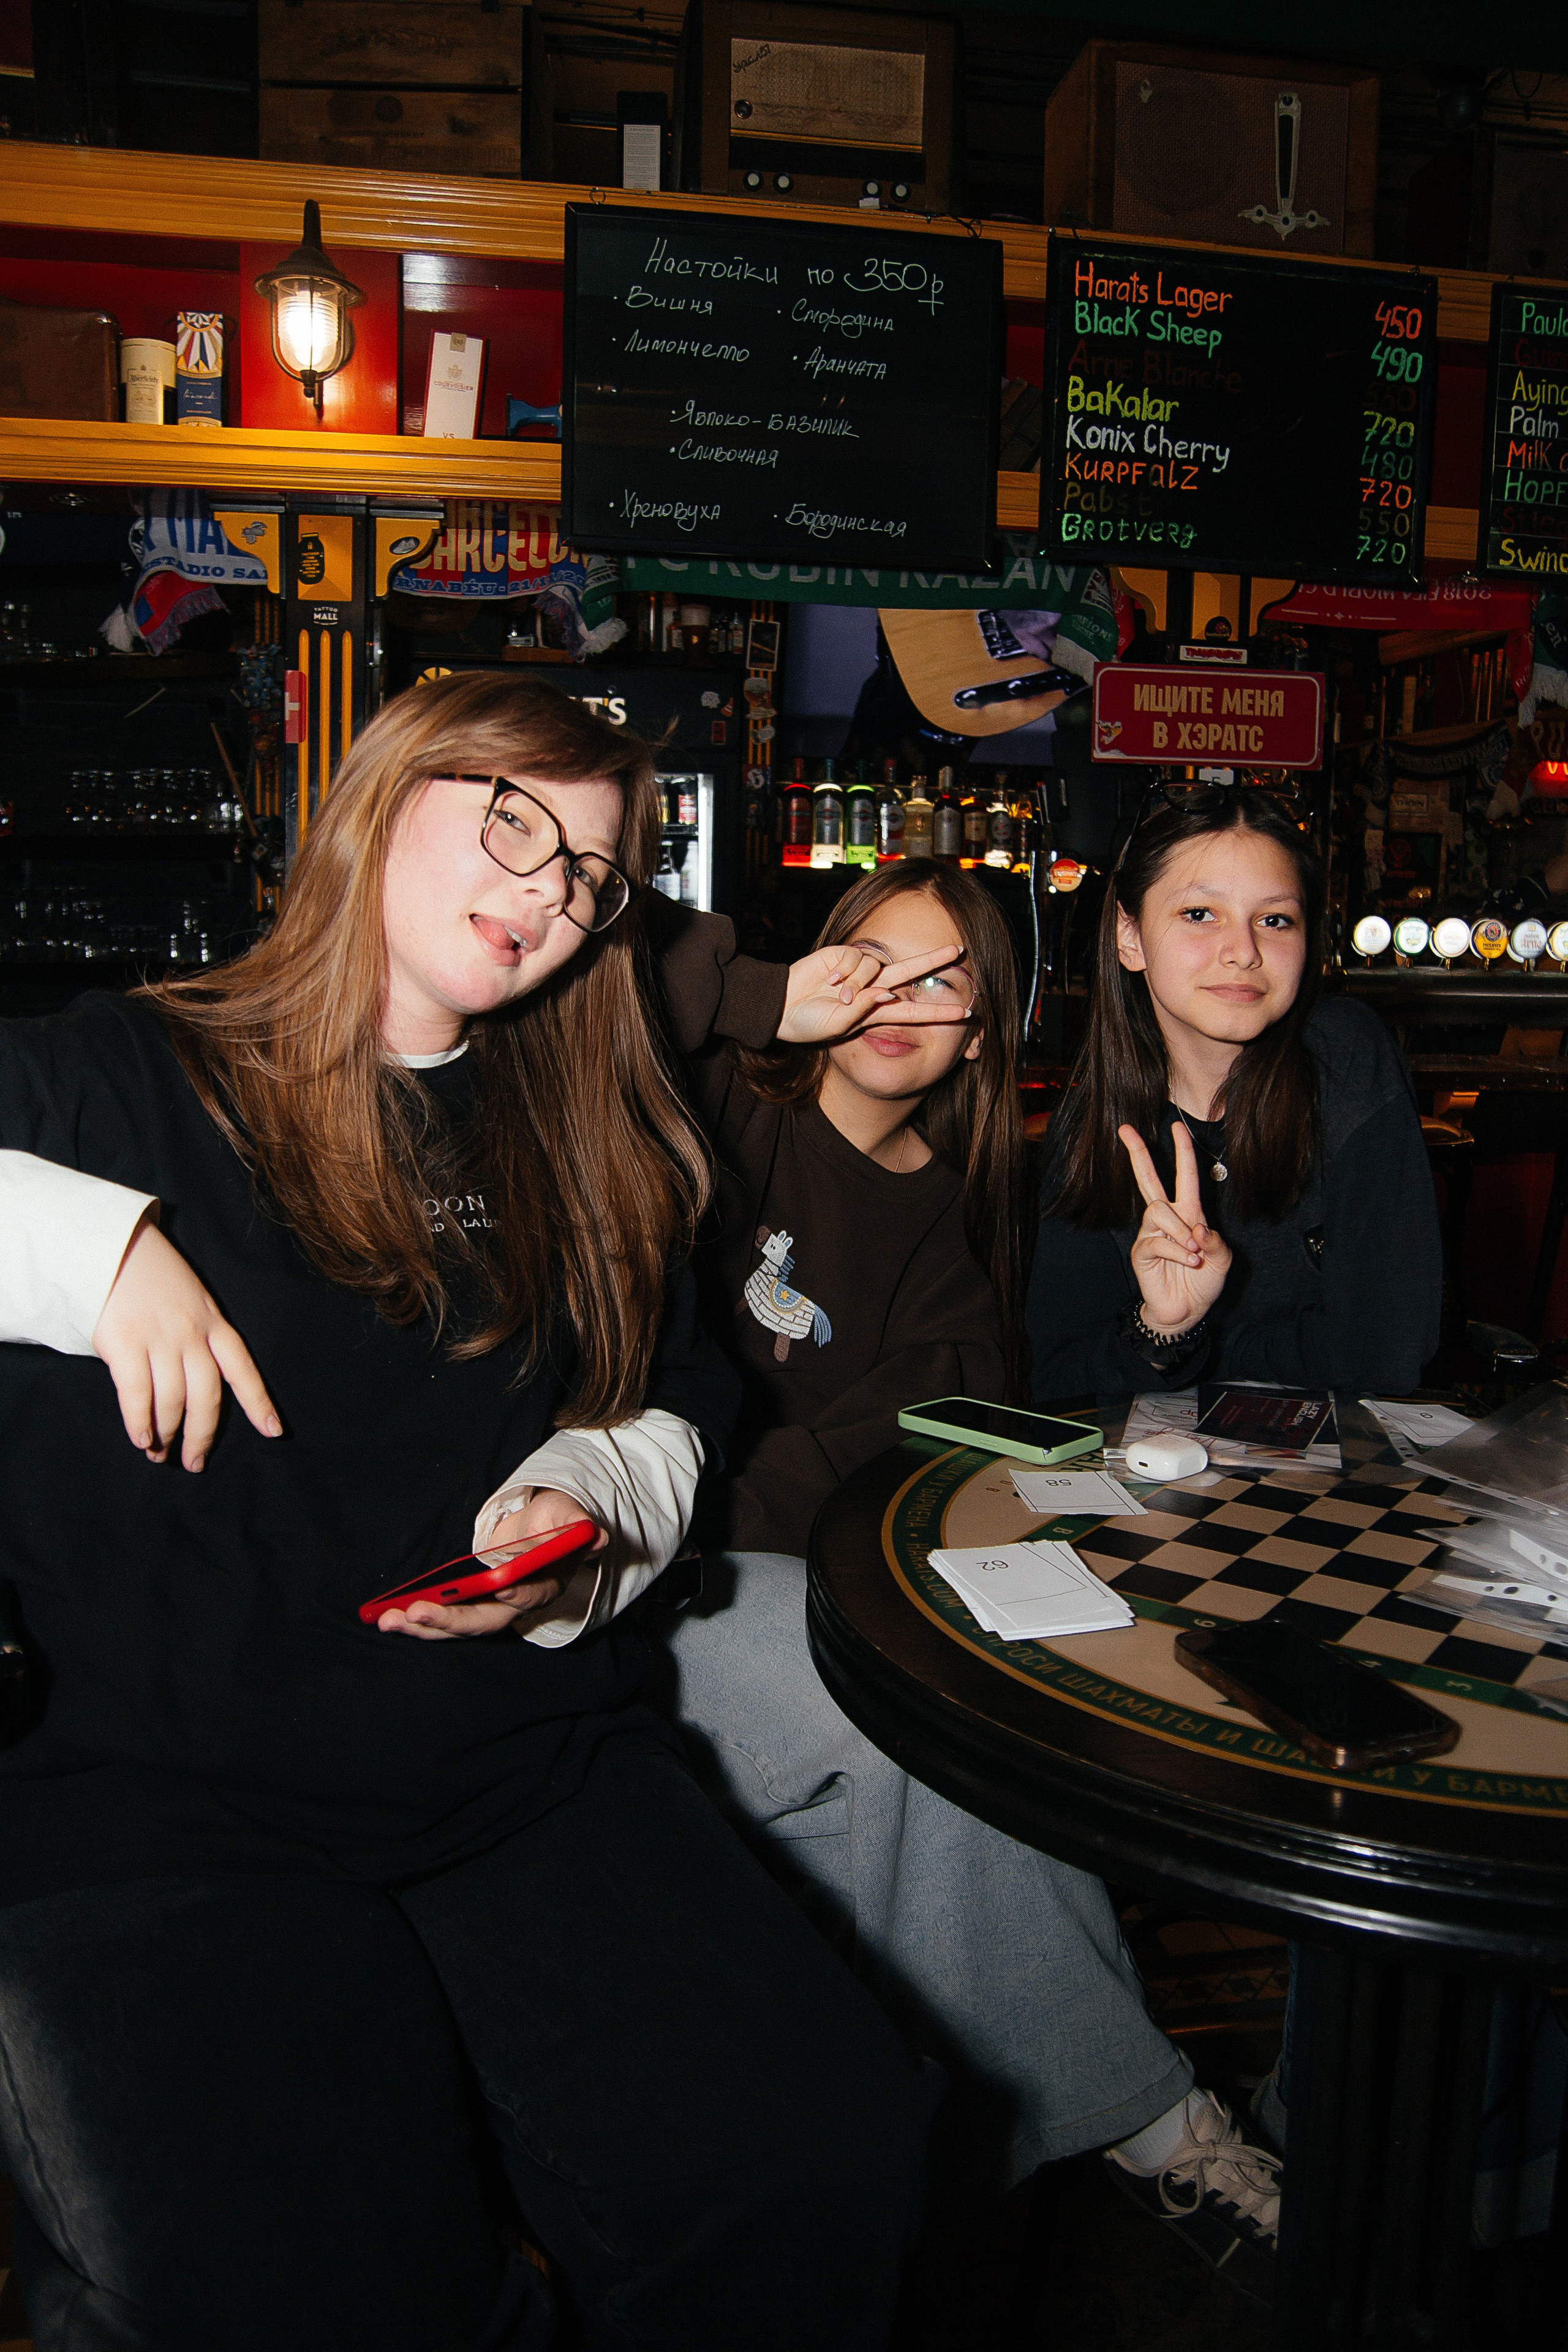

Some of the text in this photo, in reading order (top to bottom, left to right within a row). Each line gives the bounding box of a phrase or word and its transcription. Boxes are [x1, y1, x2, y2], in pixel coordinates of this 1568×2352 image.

[644, 238, 778, 284] Настойки
[808, 267, 834, 285] по
[625, 286, 712, 314] Вишня
[1074, 260, 1233, 318] Harat's Lager
[1147, 310, 1222, 359] Sheep
[1374, 300, 1422, 339] 450
[625, 330, 750, 361] Лимончелло
[1371, 340, 1423, 383] 490
[1363, 410, 1414, 448] 720
[1510, 405, 1559, 439] Palm
[1066, 415, 1230, 473] Konix Cherry
[1360, 445, 1413, 480] 480
[1360, 477, 1412, 510] 720
[785, 503, 907, 539] Бородинская
[1359, 507, 1409, 537] 550
[1356, 535, 1406, 565] 720
[1134, 684, 1284, 717] ИЩИТЕ МЕНЯ
[1153, 722, 1264, 752] В ХЭРАТС
[1046, 1479, 1072, 1487] 58
[976, 1559, 1009, 1572] 62
[1058, 1673, 1210, 1734] ШАХМАТЫ
[1215, 1727, 1243, 1746] И
[1412, 1770, 1433, 1787] У
